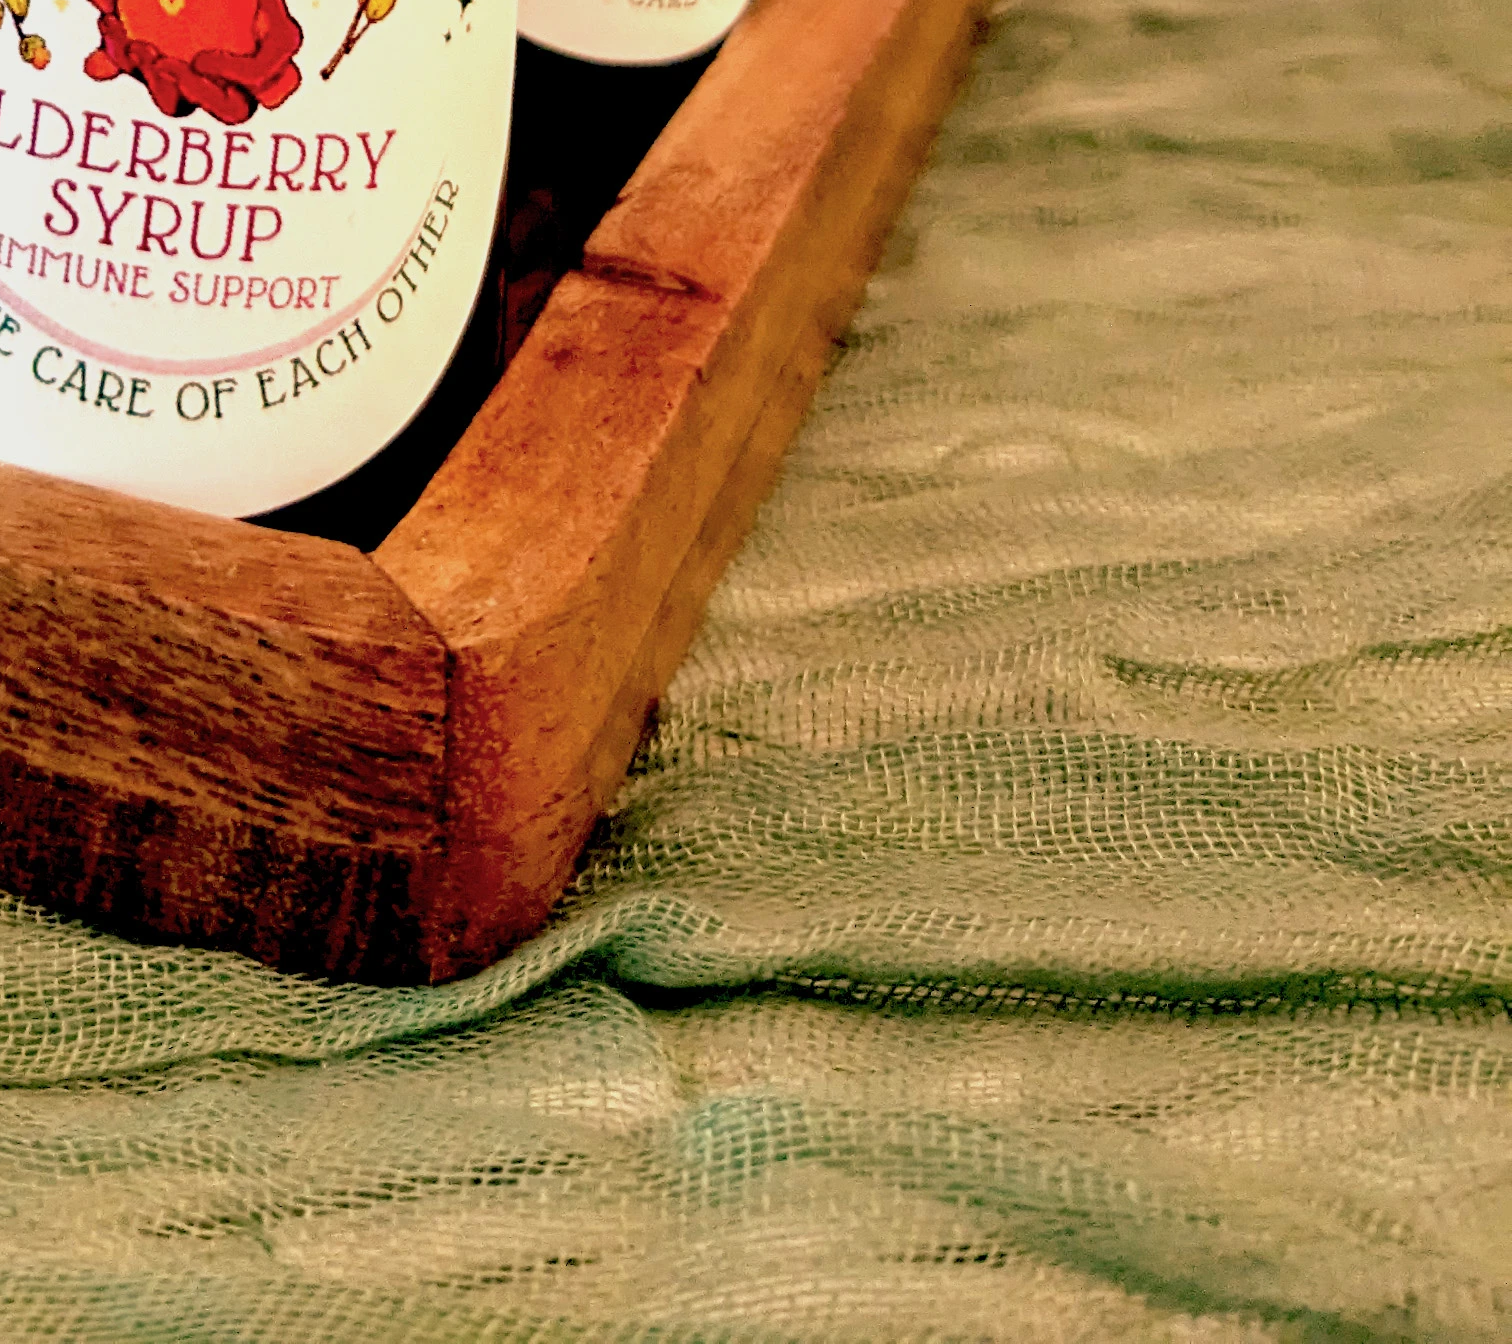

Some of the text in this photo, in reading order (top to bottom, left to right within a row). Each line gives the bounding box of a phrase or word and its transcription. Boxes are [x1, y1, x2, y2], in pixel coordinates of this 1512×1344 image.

[42, 177, 283, 263] SYRUP
[31, 343, 156, 420] CARE
[174, 377, 241, 422] OF
[255, 317, 374, 411] EACH
[374, 176, 461, 326] OTHER
[168, 271, 341, 312] SUPPORT
